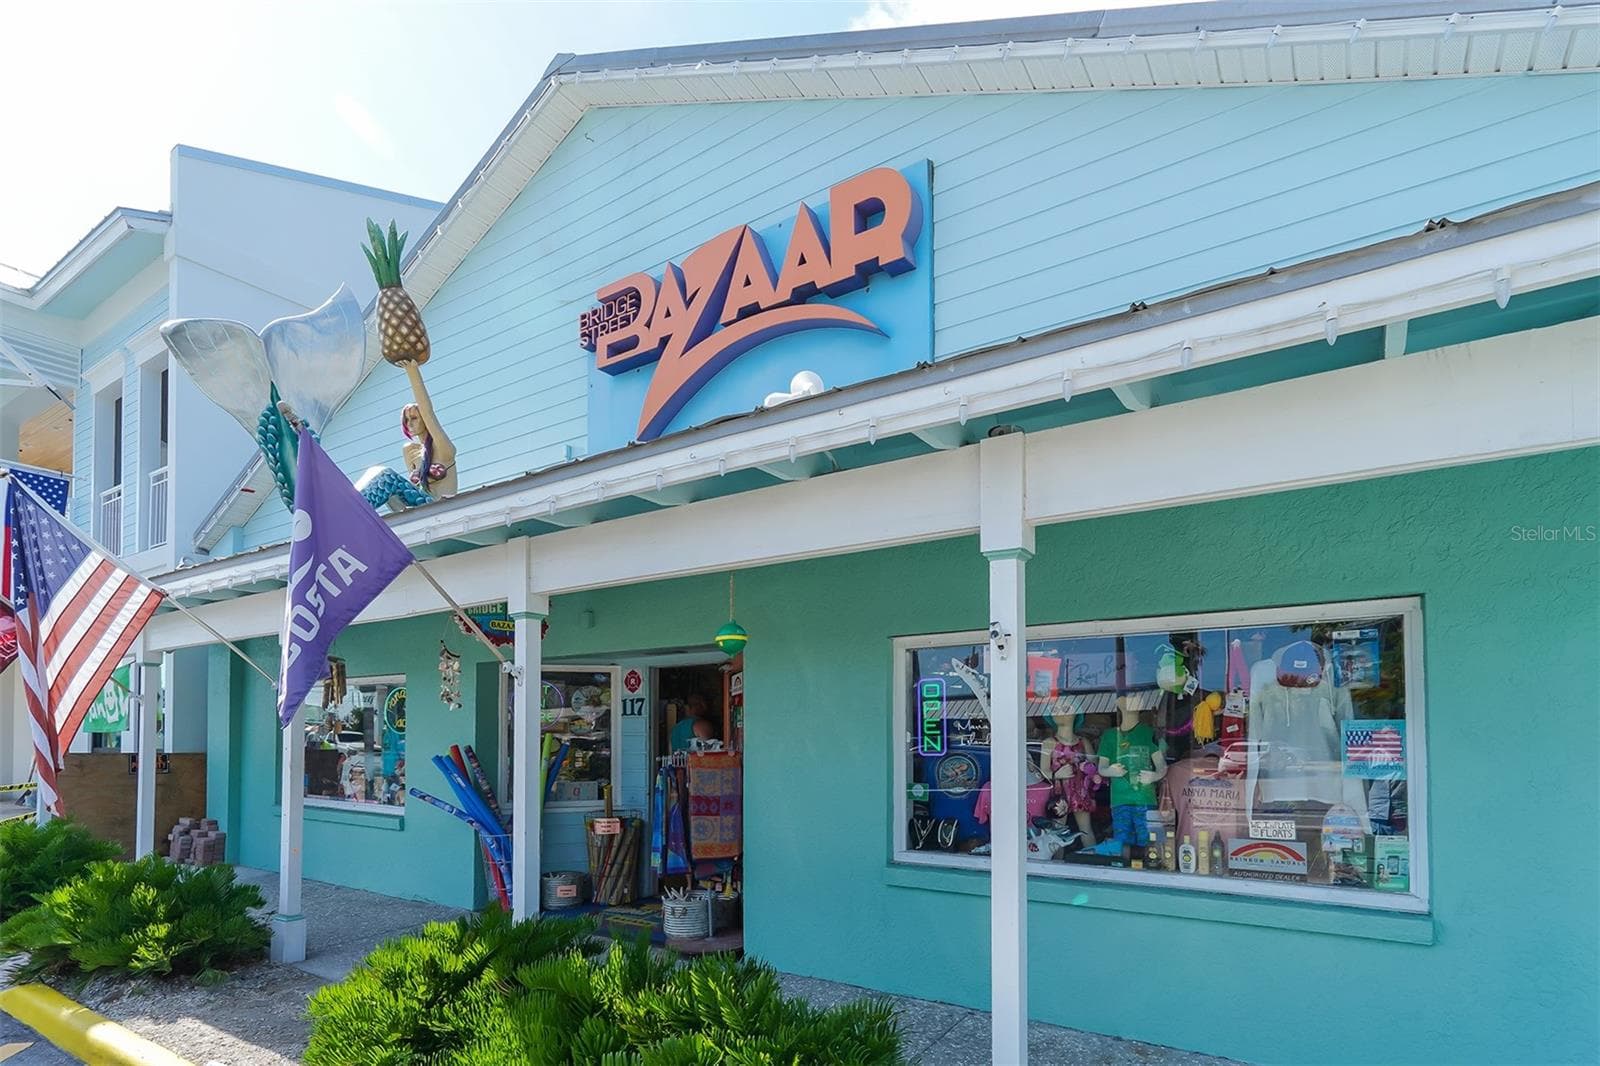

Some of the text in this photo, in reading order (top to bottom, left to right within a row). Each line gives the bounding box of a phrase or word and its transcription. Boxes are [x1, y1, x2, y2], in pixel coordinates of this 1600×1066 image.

[578, 291, 637, 331] BRIDGE
[595, 167, 913, 440] BAZAAR
[578, 309, 638, 348] STREET
[490, 620, 515, 630] BAZA
[621, 698, 645, 717] 117
[922, 682, 942, 753] OPEN
[1260, 829, 1293, 838] FLOATS
